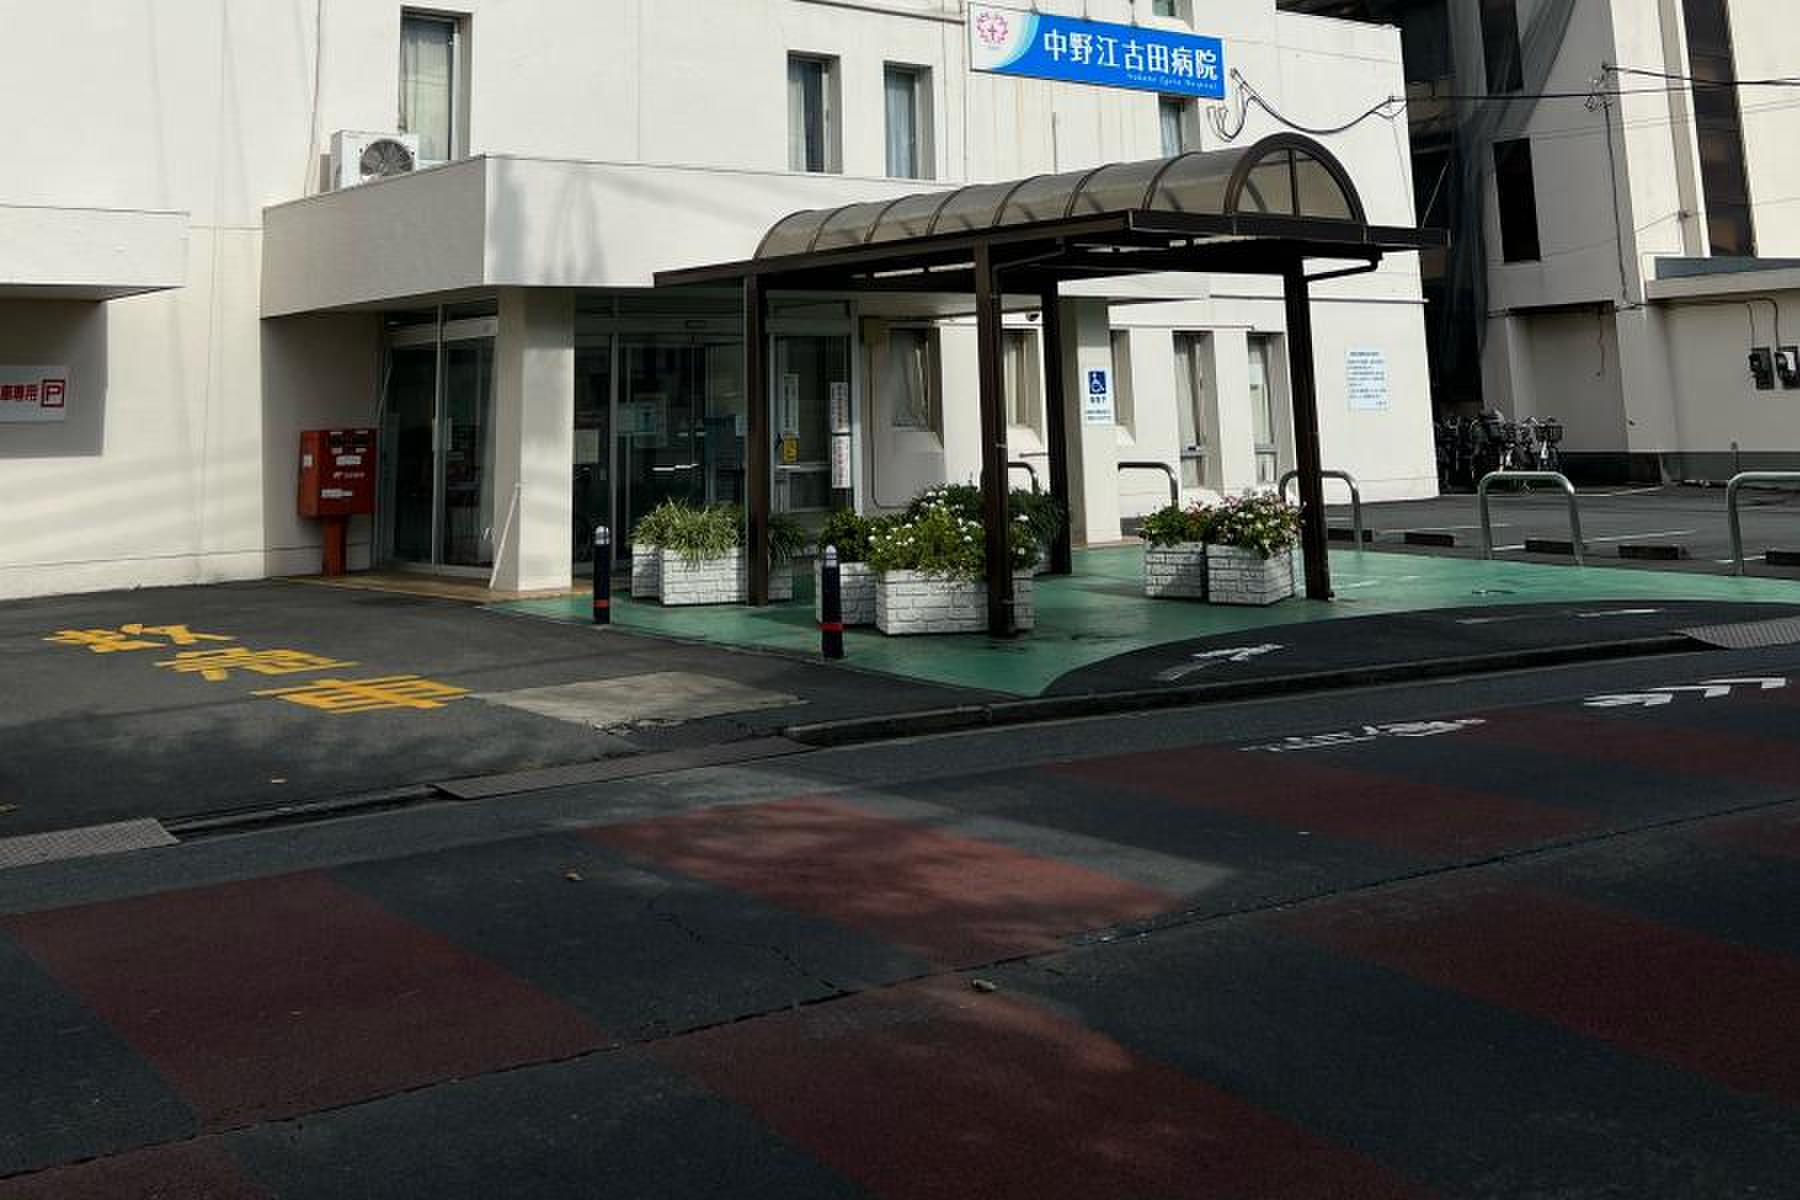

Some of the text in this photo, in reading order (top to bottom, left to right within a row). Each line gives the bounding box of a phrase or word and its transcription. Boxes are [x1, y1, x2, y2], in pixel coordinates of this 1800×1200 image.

[1043, 28, 1218, 81] 中野江古田病院
[45, 382, 64, 405] P
